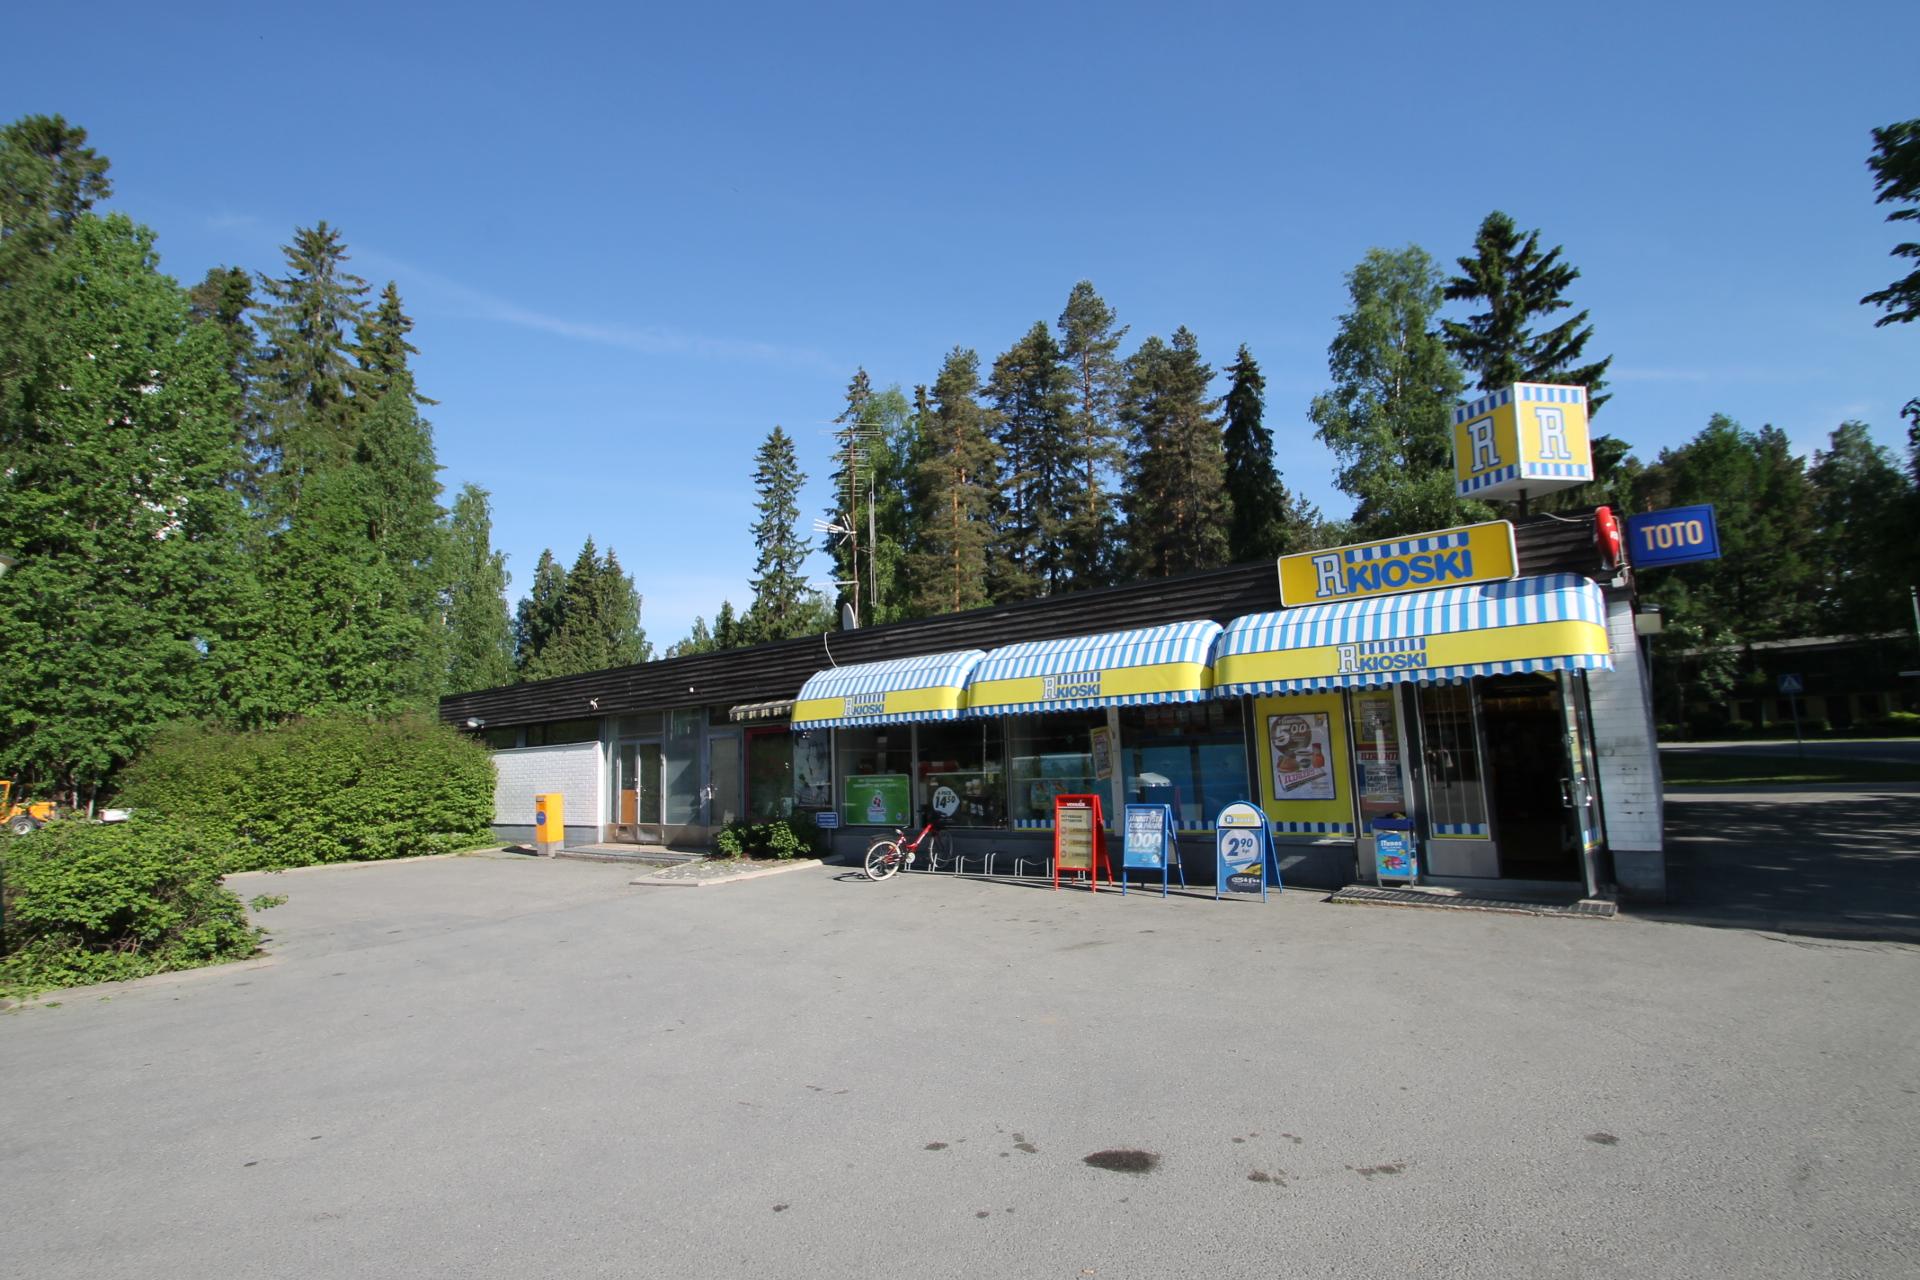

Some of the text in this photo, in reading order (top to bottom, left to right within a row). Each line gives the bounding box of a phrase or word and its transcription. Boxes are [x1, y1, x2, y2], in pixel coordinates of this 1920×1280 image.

[1467, 415, 1500, 473] R
[1535, 406, 1571, 460] R
[1640, 520, 1704, 550] TOTO
[1312, 550, 1473, 598] R KIOSKI
[1337, 645, 1427, 674] R KIOSKI
[1057, 684, 1100, 698] KIOSKI
[854, 703, 885, 715] KIOSKI
[1128, 832, 1162, 848] 1000
